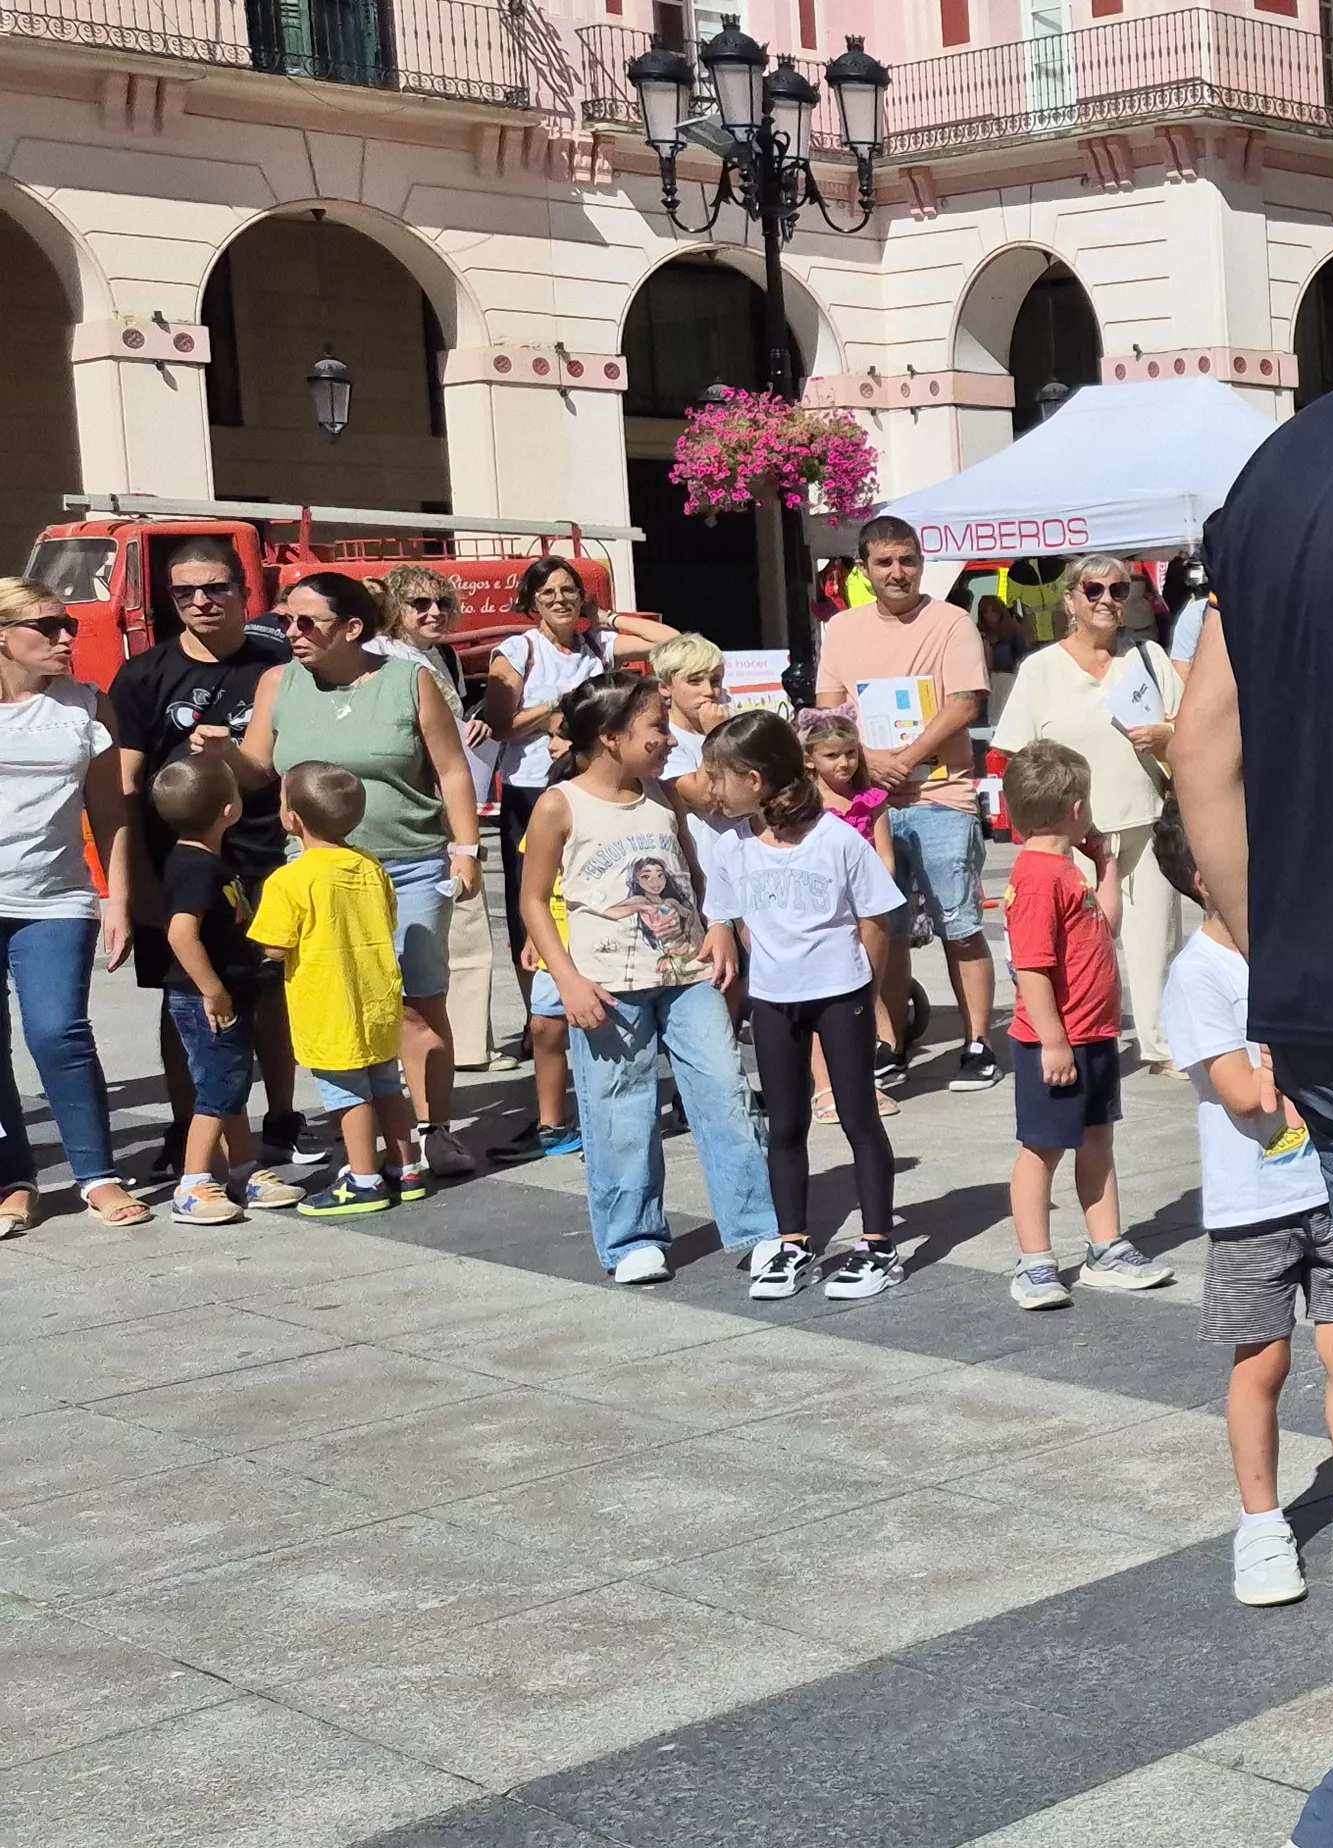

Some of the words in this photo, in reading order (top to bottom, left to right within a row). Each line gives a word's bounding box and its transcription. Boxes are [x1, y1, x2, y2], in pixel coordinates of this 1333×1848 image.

[921, 517, 1090, 553] OMBEROS
[583, 839, 627, 880] ENJOY
[626, 832, 656, 852] THE
